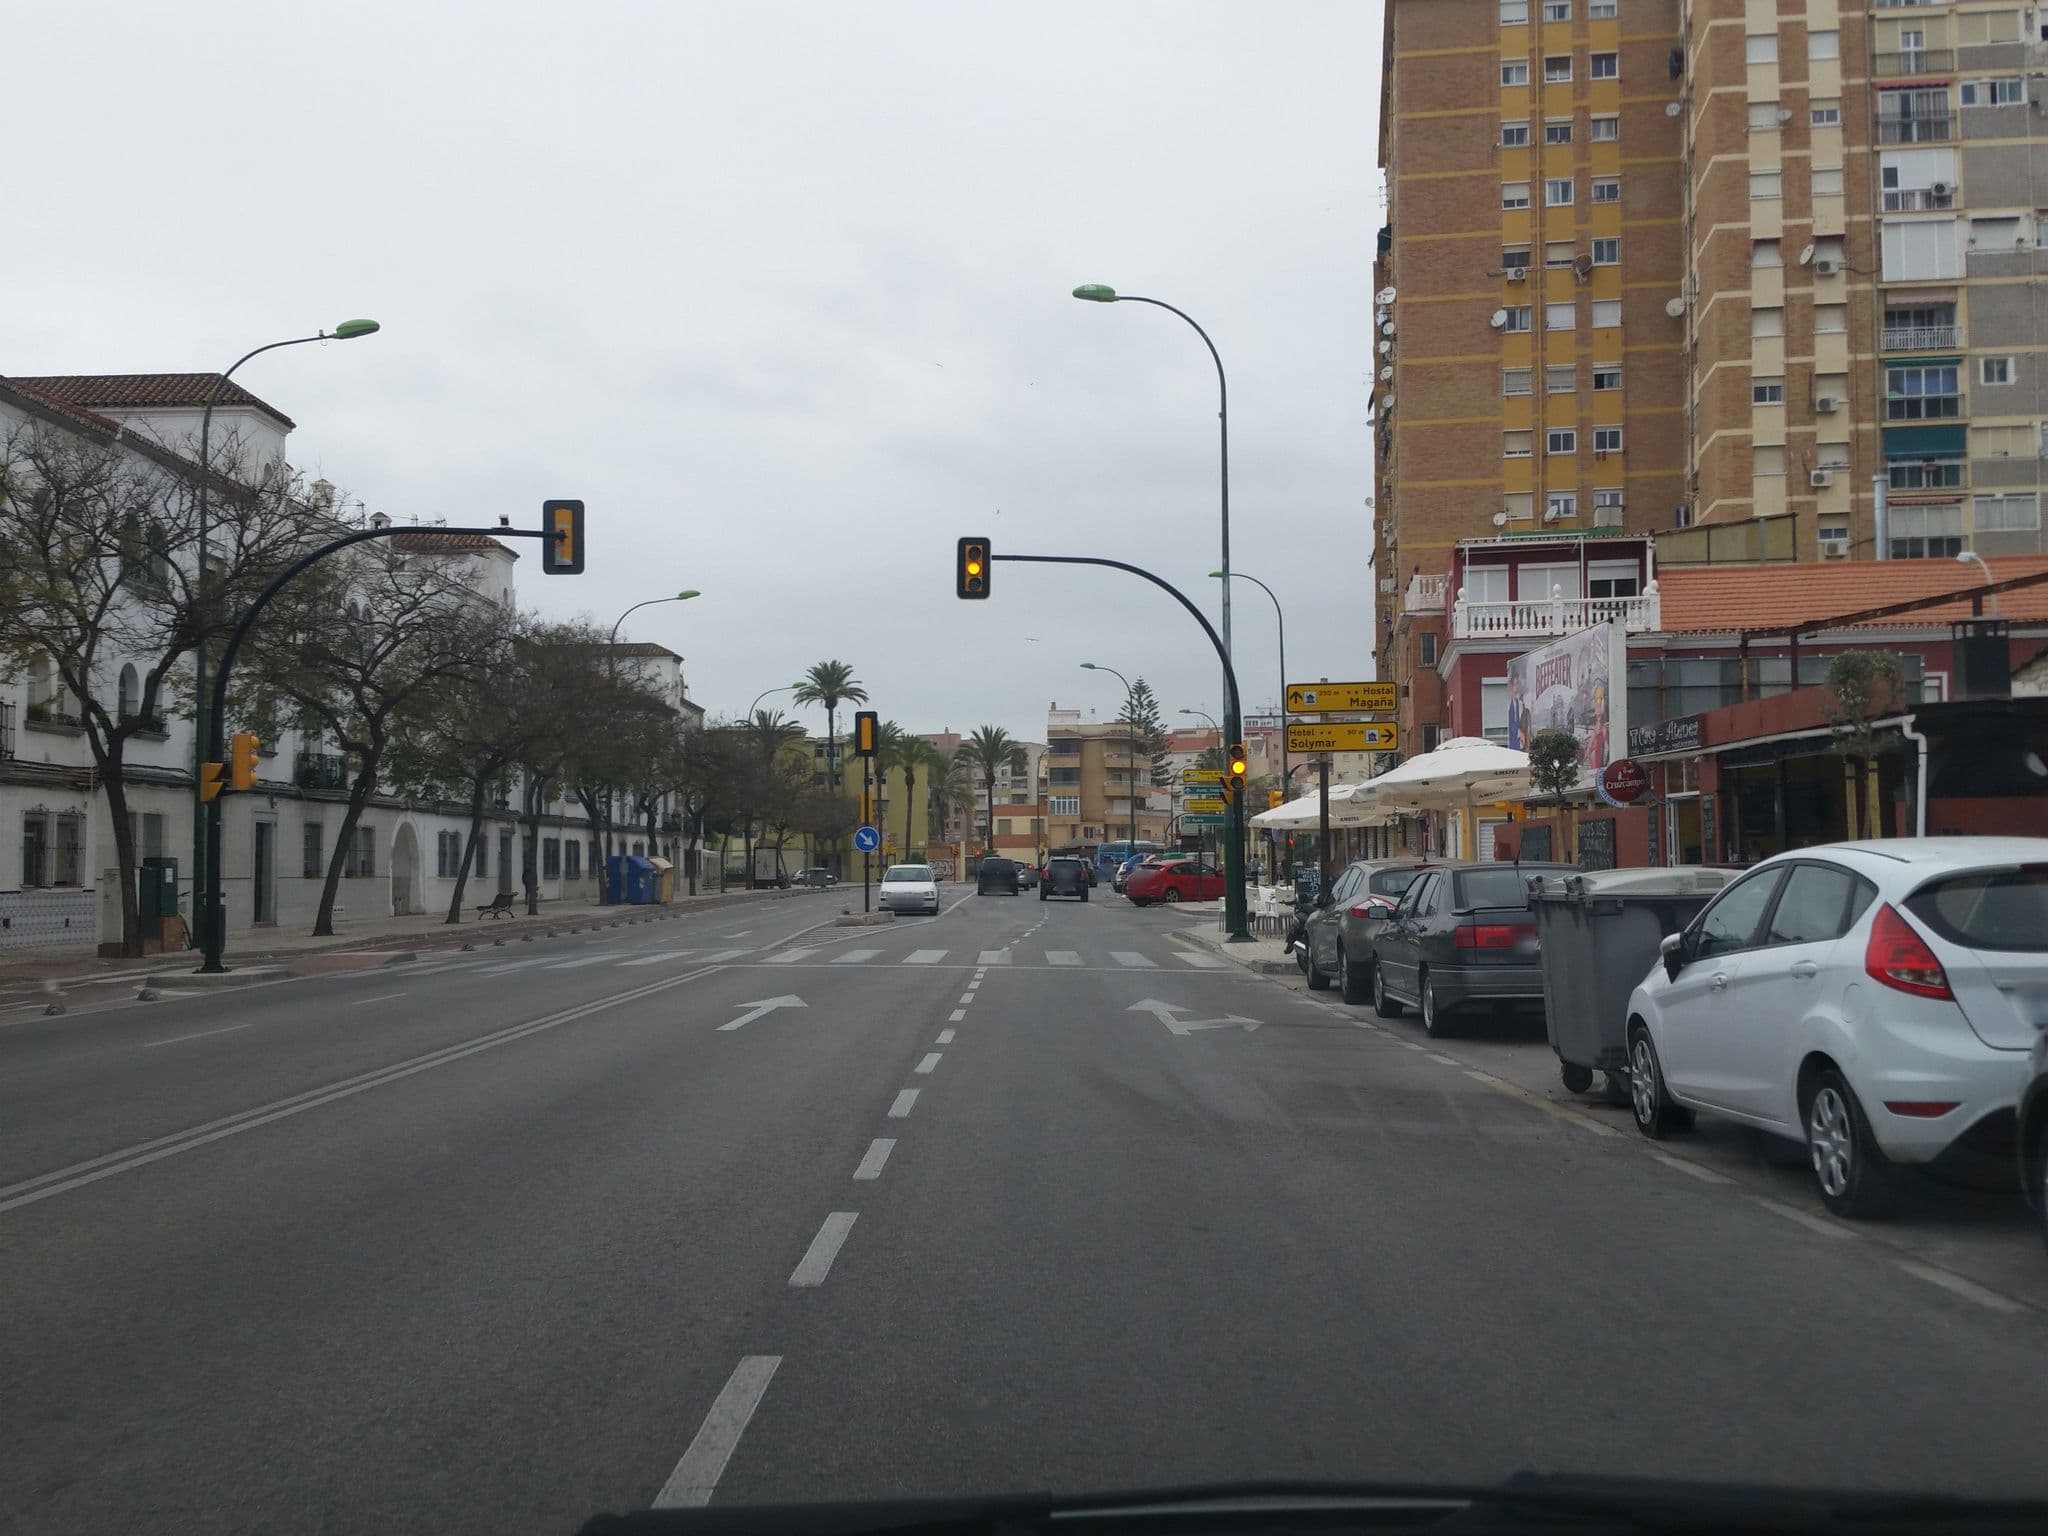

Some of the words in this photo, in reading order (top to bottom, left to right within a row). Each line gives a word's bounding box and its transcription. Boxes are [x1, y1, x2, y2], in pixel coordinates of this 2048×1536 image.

[1536, 653, 1572, 700] BEEFEATER
[1363, 686, 1394, 695] Hostal
[1350, 697, 1393, 708] Magaña
[1289, 728, 1315, 737] Hotel
[1290, 738, 1336, 749] Solymar
[1606, 779, 1645, 790] Cruzcampo
